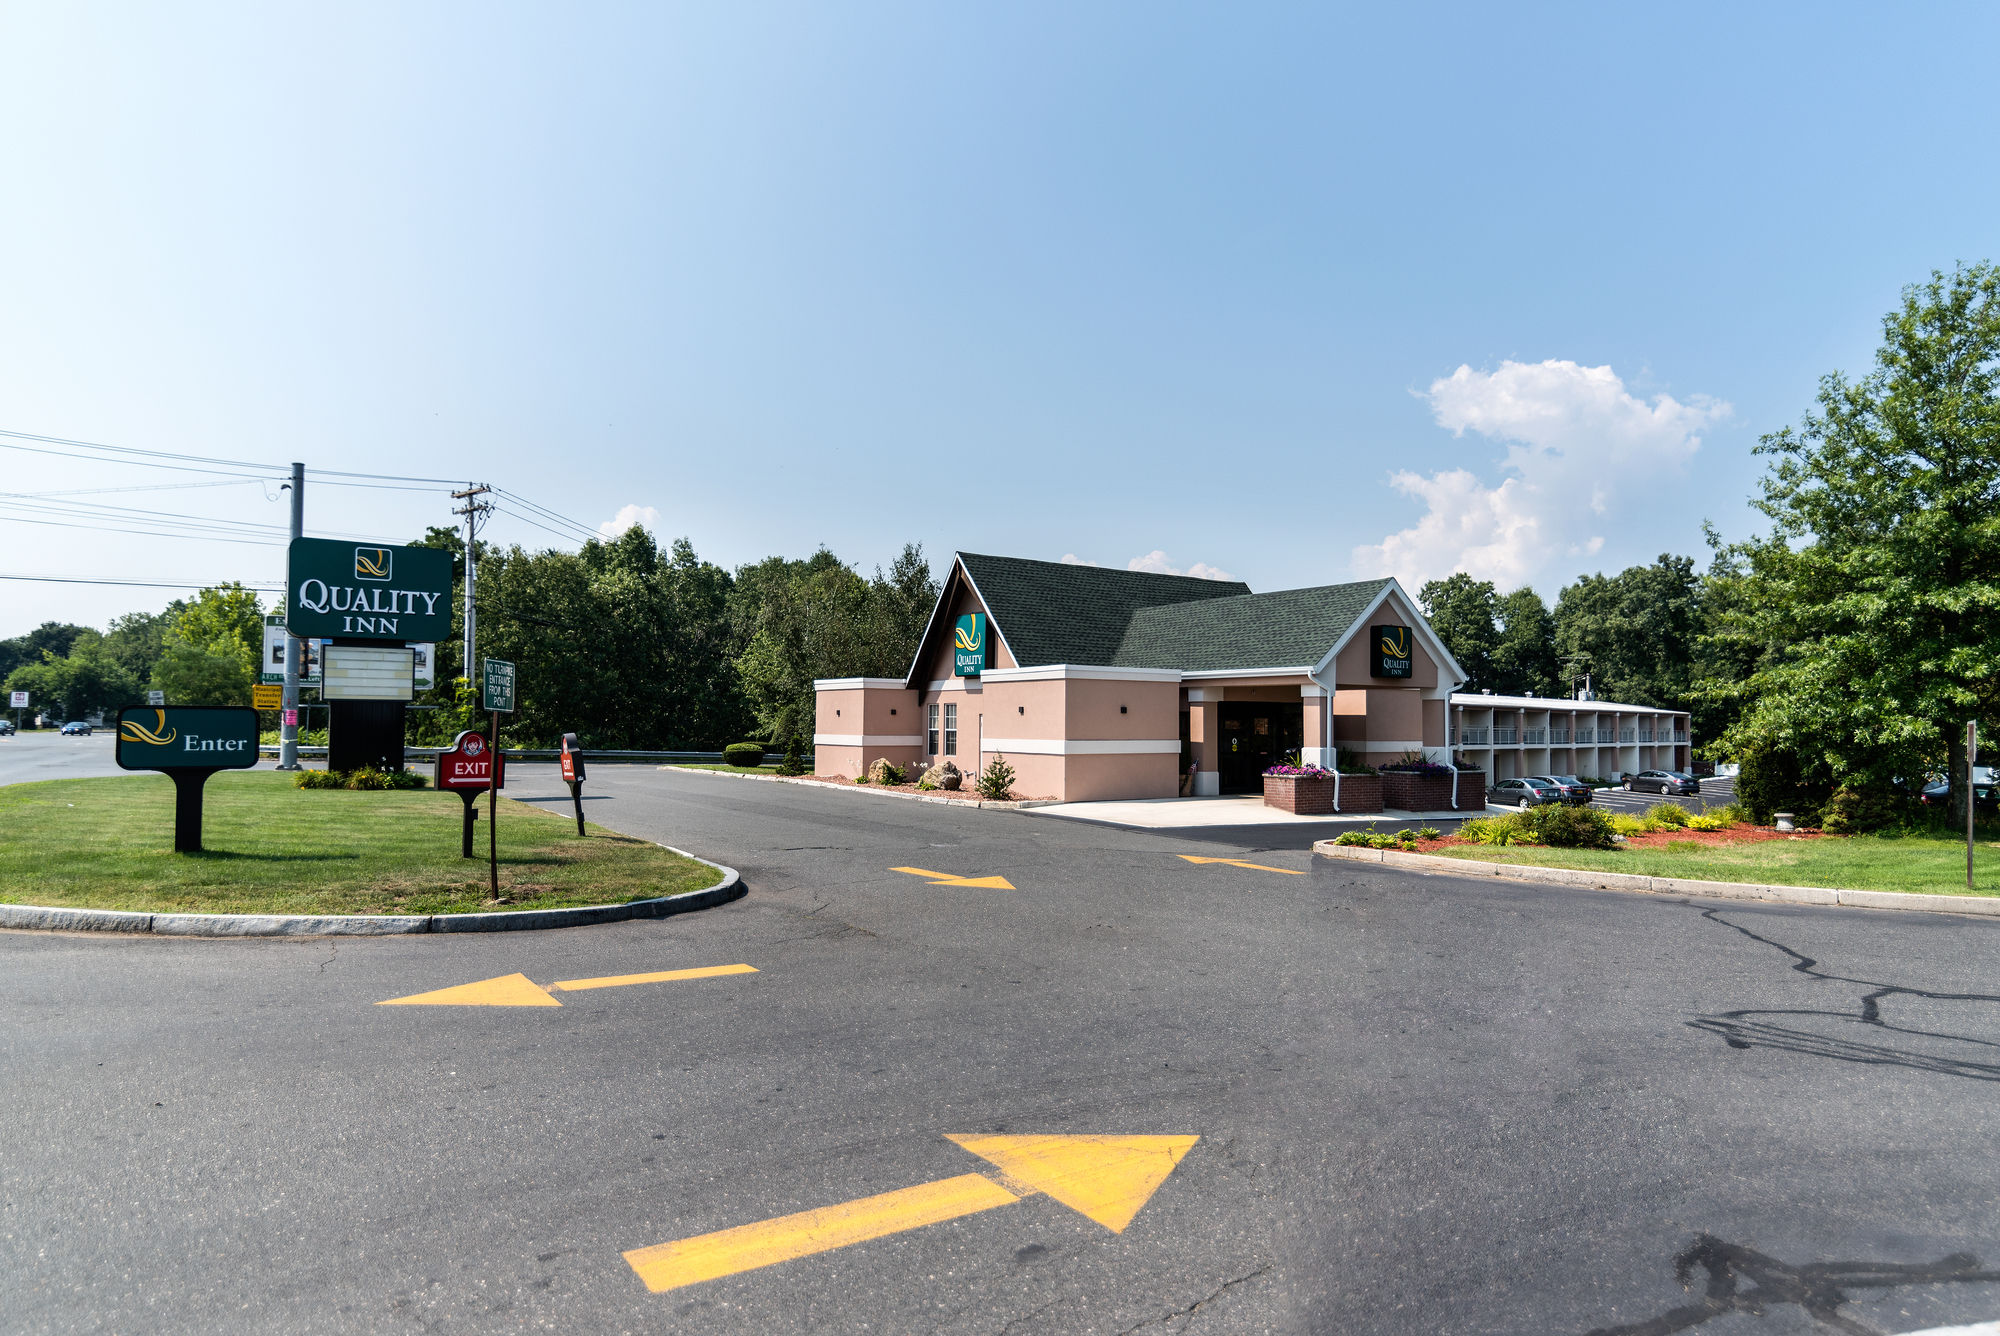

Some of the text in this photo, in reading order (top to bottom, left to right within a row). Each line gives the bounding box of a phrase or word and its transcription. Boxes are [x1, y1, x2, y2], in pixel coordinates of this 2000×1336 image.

[299, 578, 441, 615] QUALITY
[343, 616, 398, 634] INN
[957, 654, 982, 666] QUALITY
[1383, 658, 1409, 669] QUALITY
[486, 663, 493, 673] NO
[489, 674, 511, 687] ENTRANCE
[488, 685, 511, 697] FROM THIS
[183, 734, 247, 751] Enter
[454, 762, 489, 775] EXIT
